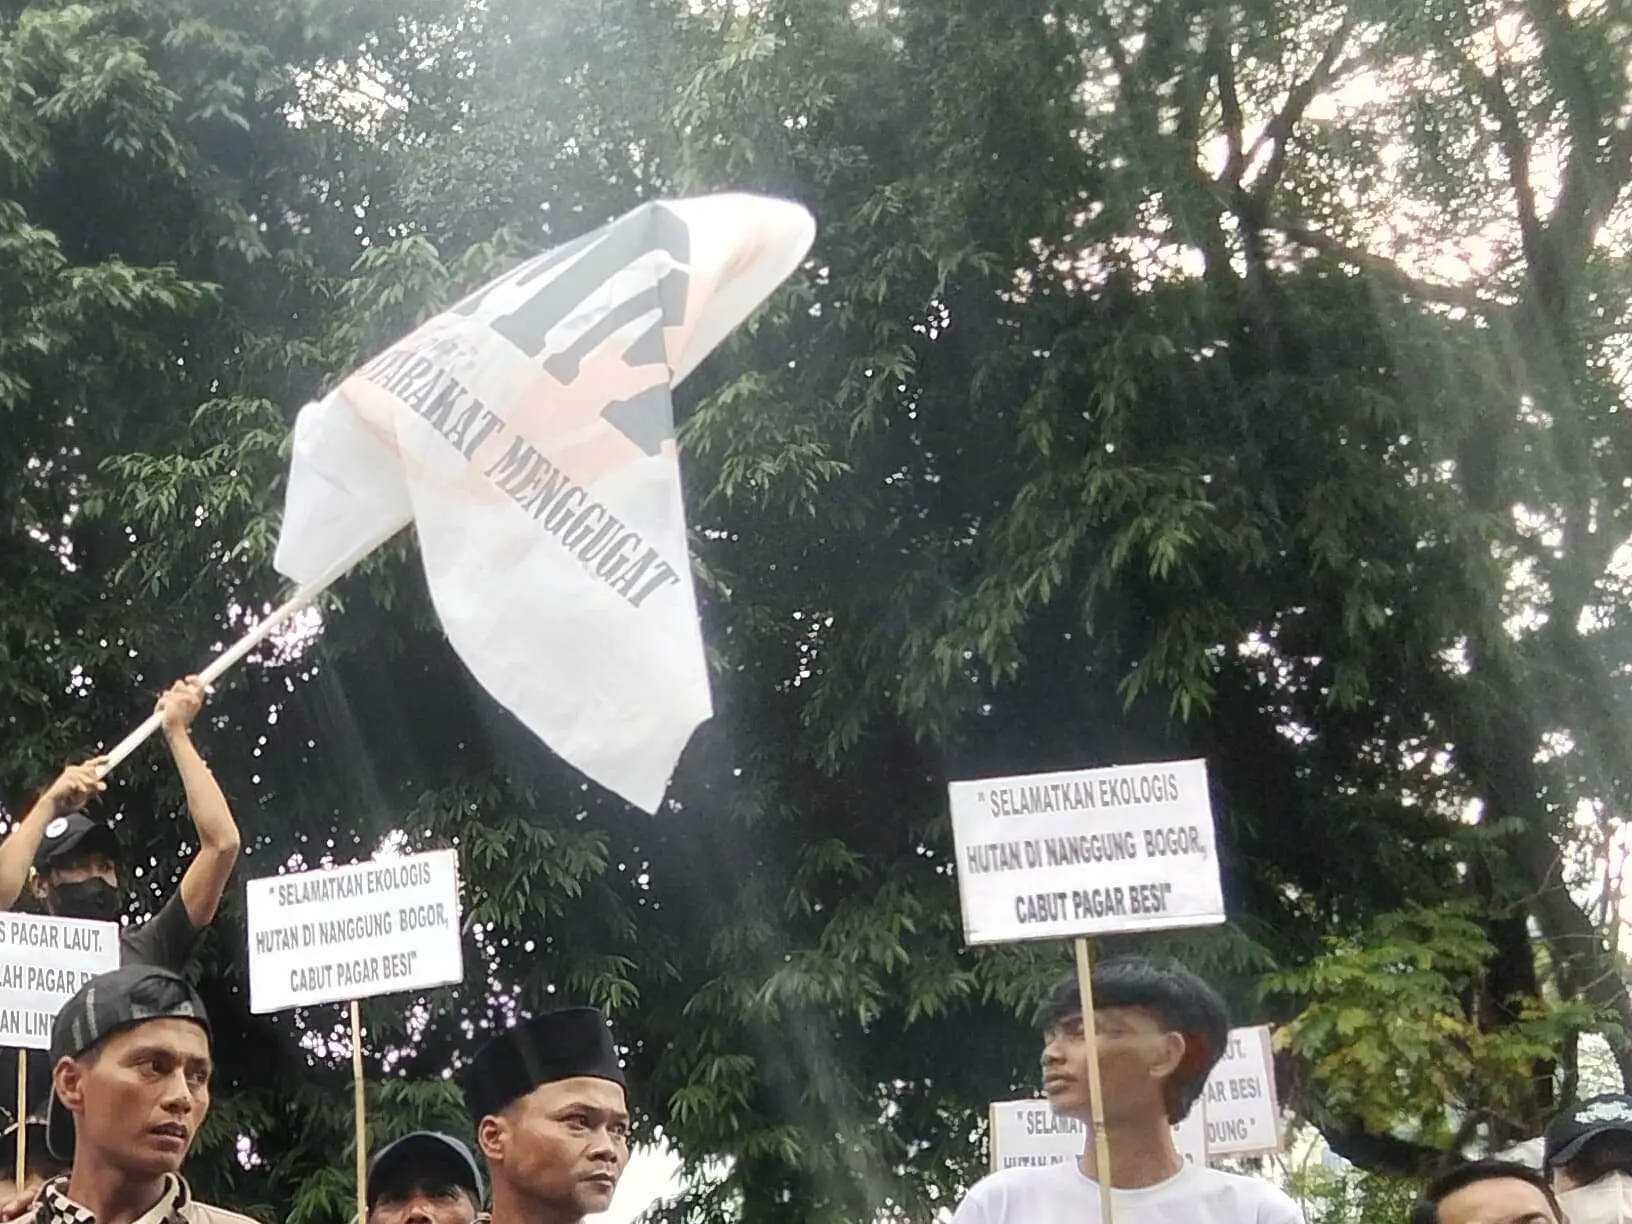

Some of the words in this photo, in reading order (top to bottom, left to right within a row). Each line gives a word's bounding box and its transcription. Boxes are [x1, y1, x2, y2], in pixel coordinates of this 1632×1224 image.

[484, 434, 680, 609] MENGGUGAT
[990, 783, 1096, 818] SELAMATKAN
[1100, 773, 1179, 807] EKOLOGIS
[966, 841, 1024, 874] HUTAN
[1025, 840, 1043, 869] DI
[1045, 831, 1137, 867] NANGGUNG
[1143, 826, 1208, 861] BOGOR,
[278, 873, 363, 907] SELAMATKAN
[367, 861, 432, 894] EKOLOGIS
[1015, 892, 1068, 924] CABUT
[1073, 886, 1125, 920] PAGAR
[11, 922, 59, 949] PAGAR
[256, 927, 300, 954] HUTAN
[303, 923, 316, 947] DI
[319, 912, 392, 945] NANGGUNG
[399, 902, 449, 932] BOGOR,
[28, 966, 76, 994] PAGAR
[290, 965, 332, 993] CABUT
[337, 957, 379, 987] PAGAR
[1229, 1077, 1262, 1100] BESI
